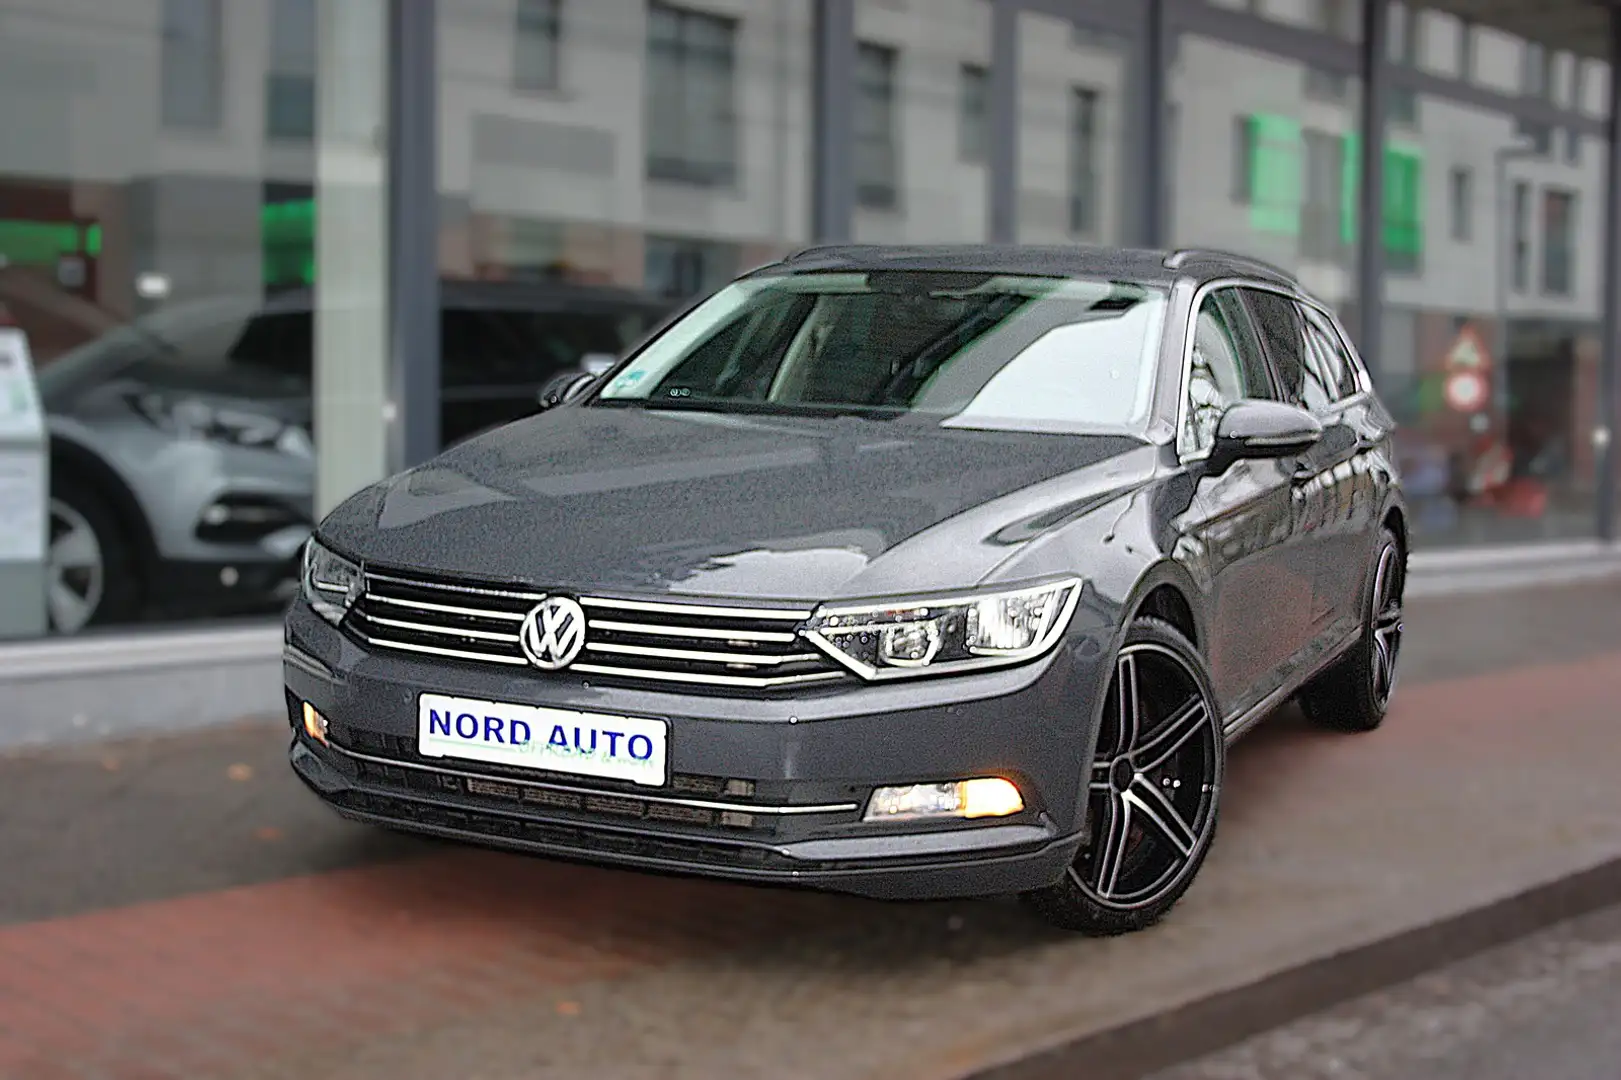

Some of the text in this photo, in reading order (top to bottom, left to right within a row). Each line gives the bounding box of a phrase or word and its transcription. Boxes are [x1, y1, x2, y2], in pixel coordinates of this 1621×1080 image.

[523, 599, 583, 665] VW
[429, 709, 653, 761] NORD AUTO
